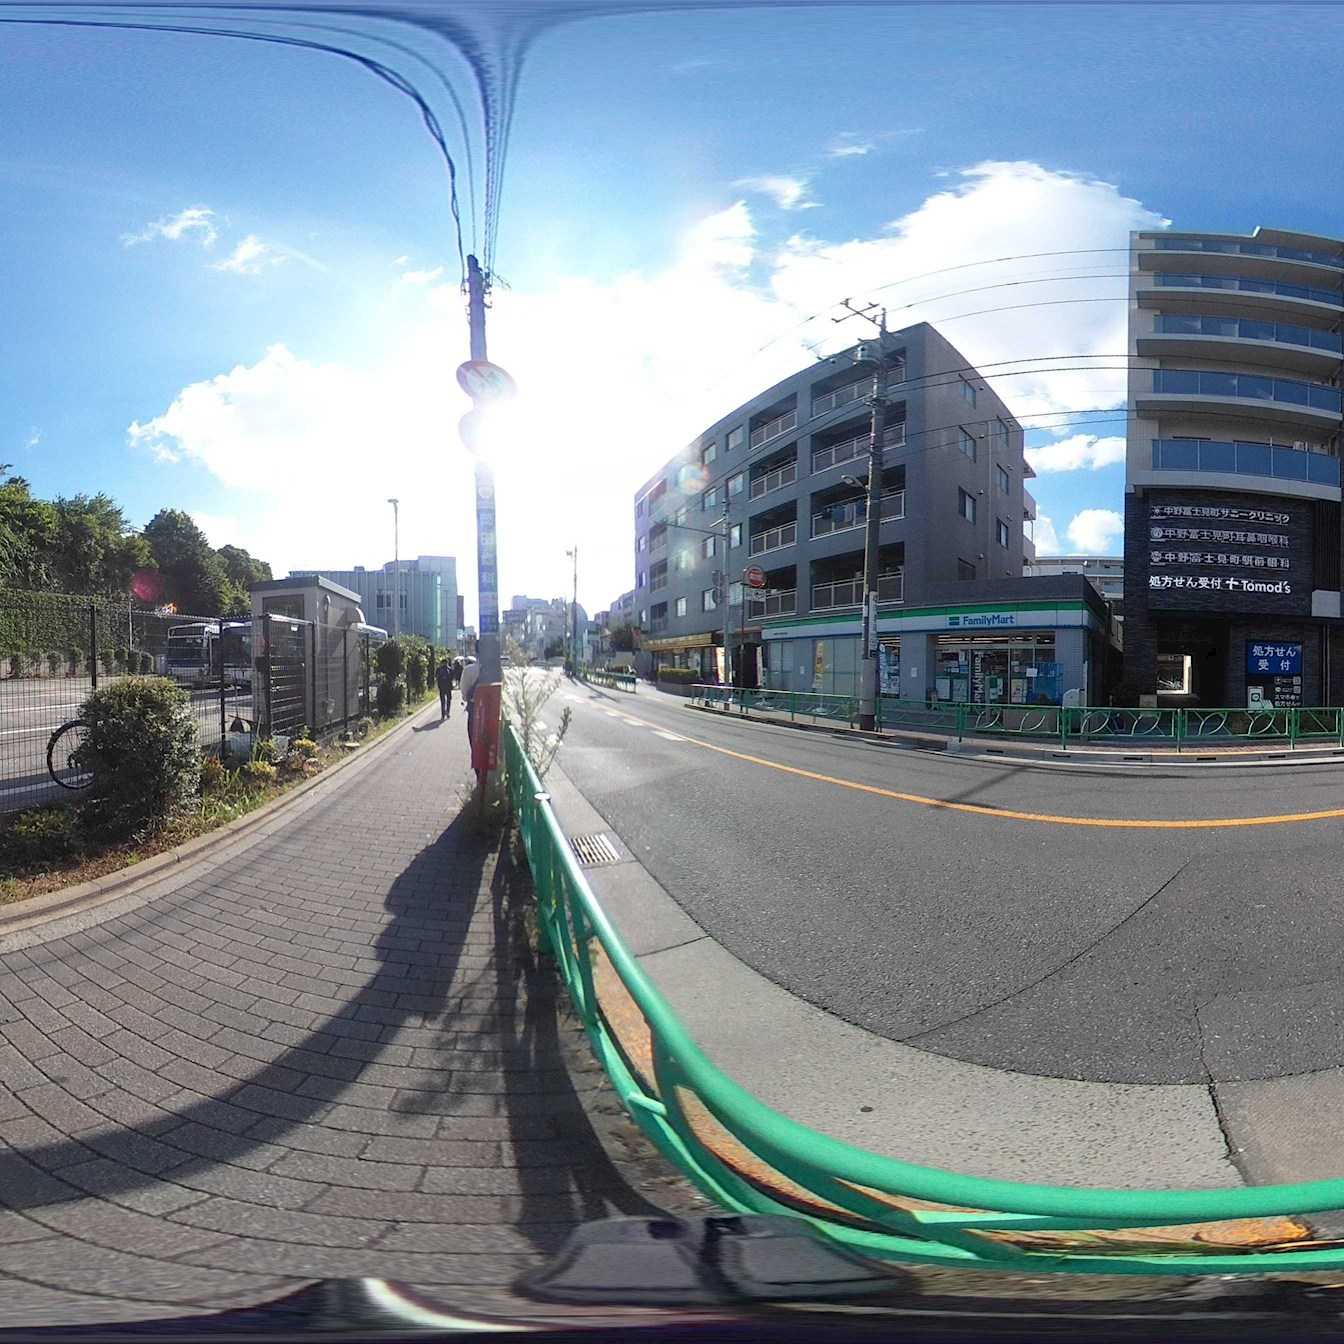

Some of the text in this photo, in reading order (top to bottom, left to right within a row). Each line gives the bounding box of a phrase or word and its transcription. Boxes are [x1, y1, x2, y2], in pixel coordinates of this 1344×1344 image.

[1149, 575, 1292, 594] 処方せん受付 Tomod's
[962, 614, 1016, 626] FamilyMart
[1252, 645, 1297, 657] 処方せん
